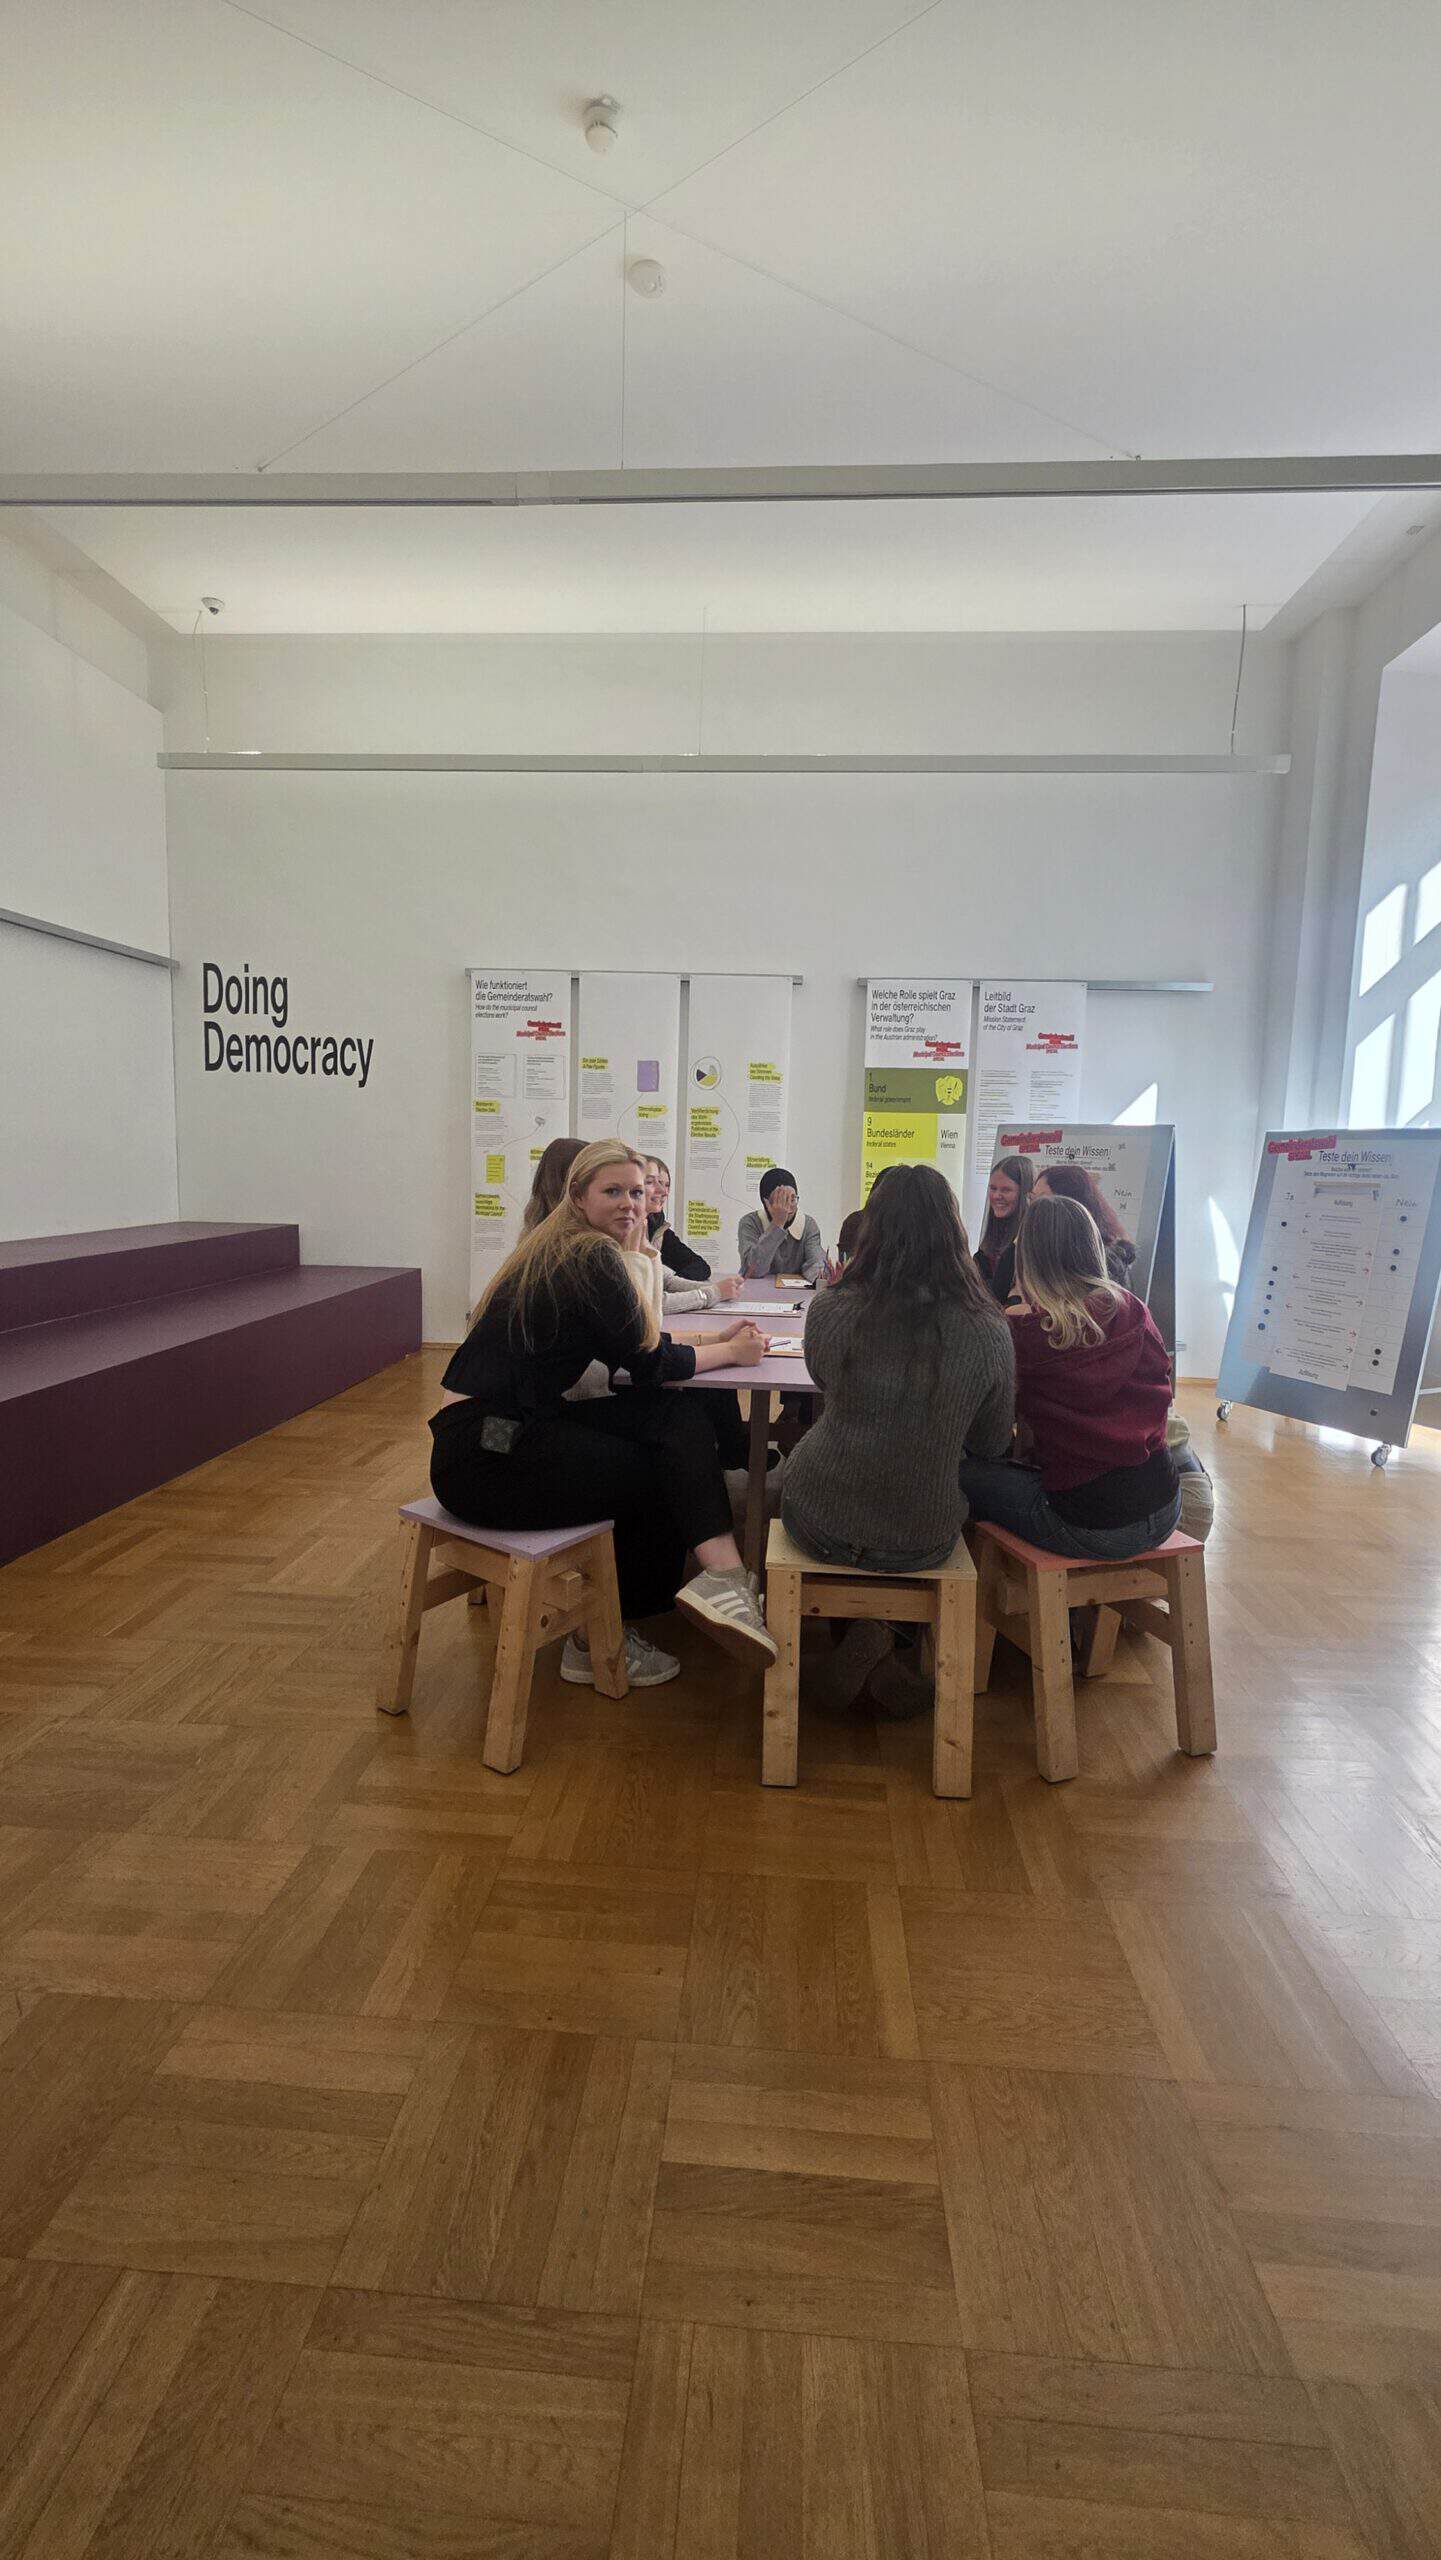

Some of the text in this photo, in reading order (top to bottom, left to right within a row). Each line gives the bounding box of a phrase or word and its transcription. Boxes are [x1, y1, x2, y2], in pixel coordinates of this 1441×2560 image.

[475, 980, 527, 990] Wie funktioniert
[203, 963, 288, 1028] Doing
[476, 991, 553, 1002] die Gemeinderatswahl?
[871, 989, 956, 1001] Welche Rolle spielt Graz
[984, 991, 1012, 1001] Leitbild
[872, 1001, 951, 1012] in der österreichischen
[984, 1003, 1036, 1014] der Stadt Graz
[871, 1013, 915, 1025] Verwaltung?
[916, 1026, 926, 1034] play
[997, 1024, 1006, 1032] City
[204, 1021, 374, 1088] Democracy
[869, 1083, 887, 1093] Bund
[867, 1116, 872, 1126] 9
[867, 1128, 915, 1139] Bundesländer
[940, 1129, 959, 1139] Wien
[1045, 1144, 1064, 1156] Teste
[1064, 1145, 1081, 1157] dein
[1318, 1150, 1340, 1162] Teste
[1341, 1151, 1359, 1162] dein
[1114, 1189, 1133, 1198] Nein
